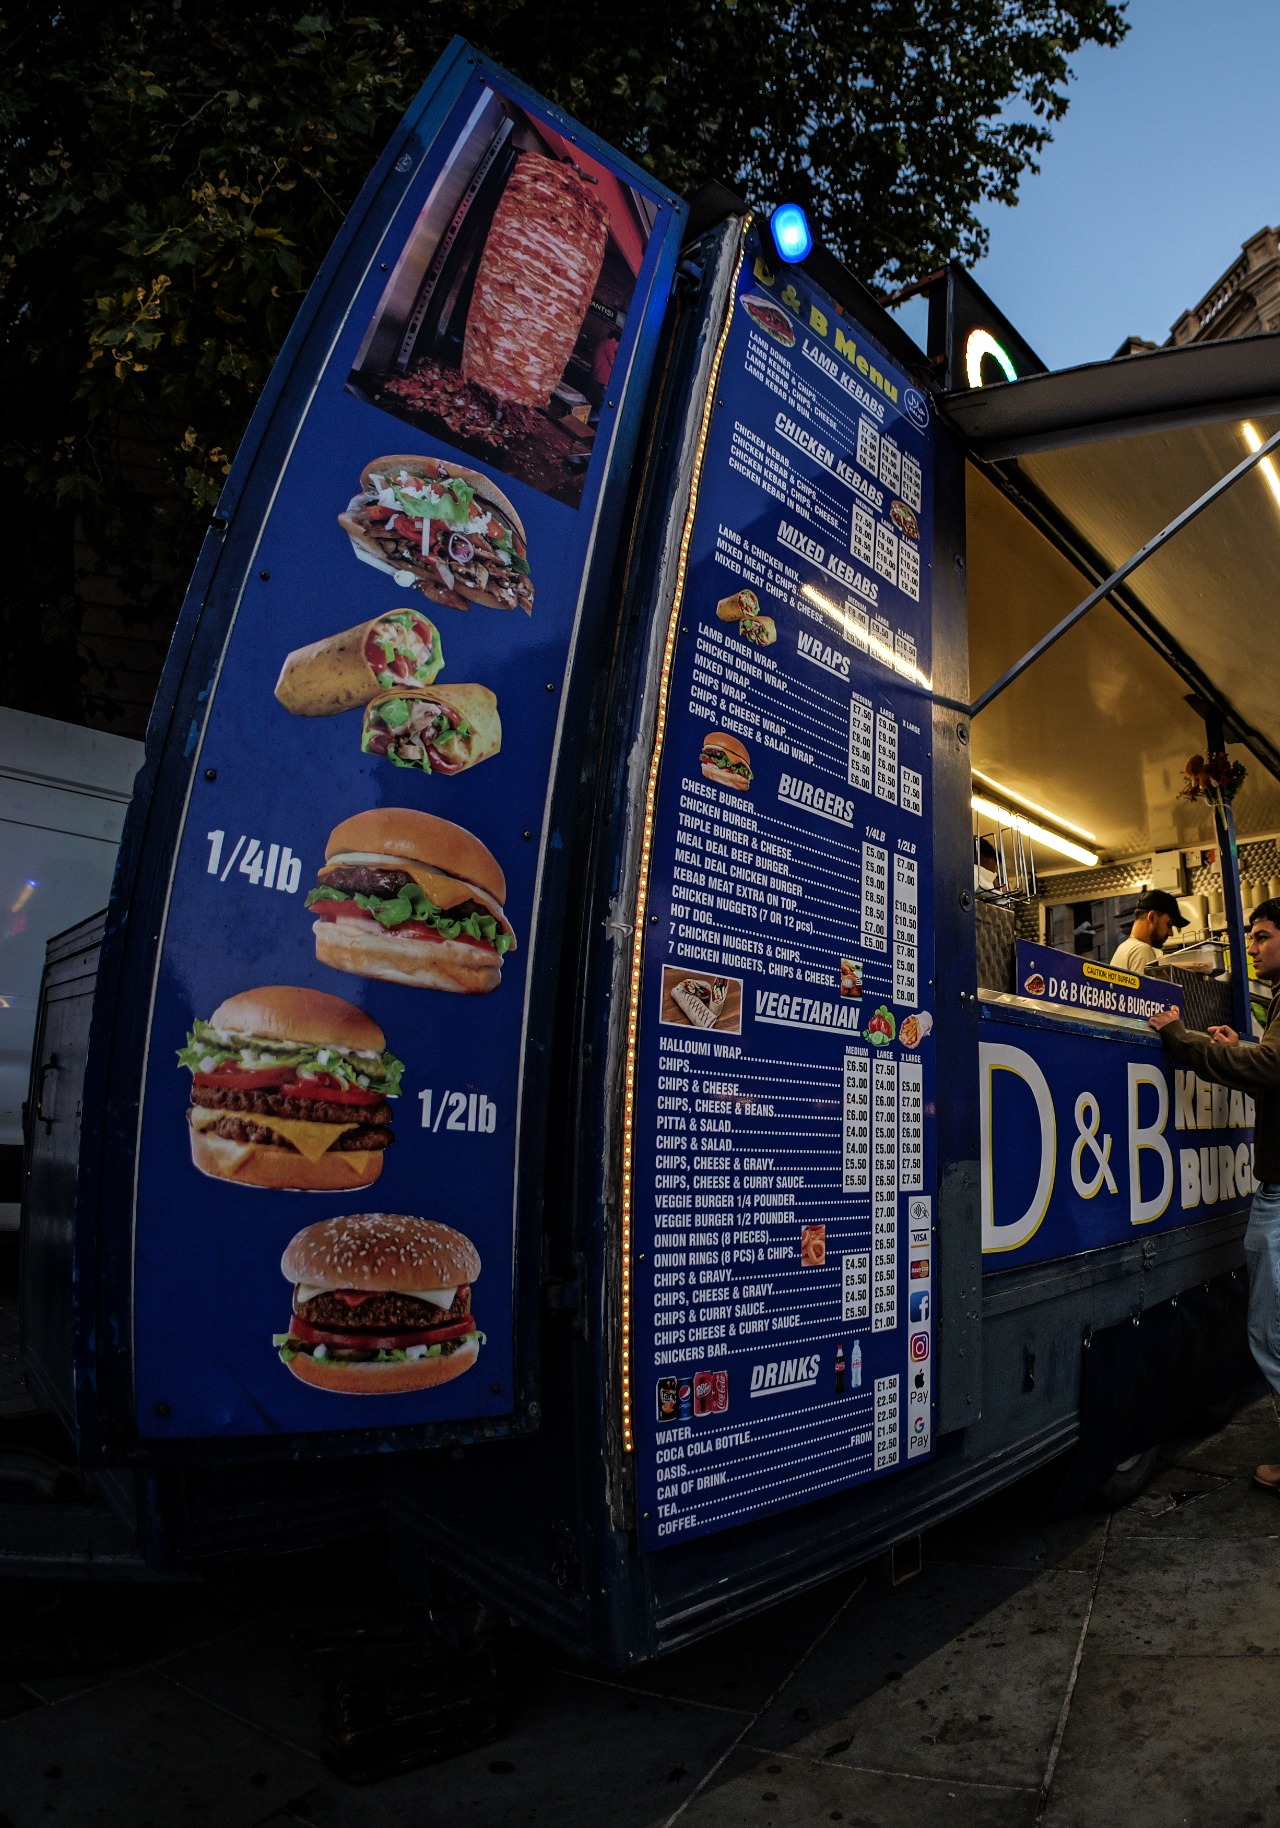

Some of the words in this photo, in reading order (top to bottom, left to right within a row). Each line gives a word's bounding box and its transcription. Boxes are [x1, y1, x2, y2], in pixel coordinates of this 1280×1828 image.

[750, 330, 768, 352] LAMB
[770, 346, 791, 369] DONER
[782, 284, 800, 315] &
[810, 305, 828, 336] B
[835, 328, 898, 403] Menu
[748, 340, 766, 362] LAMB
[769, 356, 790, 381] KEBAB
[791, 375, 796, 386] &
[798, 380, 816, 402] CHIPS
[802, 338, 839, 380] LAMB
[840, 369, 885, 418] KEBABS
[735, 421, 765, 450] CHICKEN
[768, 444, 790, 468] KEBAB
[775, 412, 834, 471] CHICKEN
[836, 458, 884, 508] KEBABS
[729, 457, 760, 486] CHICKEN
[762, 480, 785, 503] KEBAB
[787, 497, 794, 509] IN
[796, 503, 810, 520] BUN
[719, 524, 741, 548] LAMB
[743, 538, 749, 552] &
[751, 544, 782, 572] CHICKEN
[785, 564, 799, 582] MIX
[778, 520, 823, 566] MIXED
[828, 552, 878, 601] KEBABS
[717, 538, 741, 562] MIXED
[744, 553, 766, 576] MEAT
[768, 566, 773, 580] &
[775, 570, 797, 593] CHIPS
[698, 623, 721, 644] LAMB
[725, 636, 751, 659] DONER
[754, 650, 777, 671] WRAP
[798, 631, 850, 674] WRAPS
[695, 654, 721, 676] MIXED
[725, 666, 750, 688] WRAP
[853, 704, 871, 720] £7.50
[689, 701, 718, 726] CHIPS,
[721, 715, 753, 739] CHEESE
[756, 729, 762, 743] &
[764, 733, 789, 754] SALAD
[792, 744, 814, 764] WRAP
[878, 718, 896, 734] £9.00
[682, 778, 716, 801] CHEESE
[719, 791, 754, 813] BURGER
[778, 773, 854, 820] BURGERS
[679, 813, 710, 834] TRIPLE
[714, 824, 748, 846] BURGER
[751, 836, 758, 849] &
[761, 839, 792, 859] CHEESE
[865, 826, 886, 842] 1/4LB
[677, 830, 702, 850] MEAL
[706, 839, 728, 858] DEAL
[731, 847, 753, 865] BEEF
[756, 855, 789, 876] BURGER
[866, 846, 885, 862] £5.00
[897, 838, 916, 854] 1/2LB
[206, 829, 302, 894] 1/4lb
[674, 866, 705, 888] KEBAB
[709, 876, 733, 895] MEAT
[736, 884, 764, 903] EXTRA
[767, 892, 778, 906] ON
[781, 896, 797, 911] TOP
[866, 875, 884, 890] £9.00
[671, 903, 690, 920] HOT
[693, 909, 713, 925] DOG
[672, 885, 713, 908] CHICKEN
[717, 897, 757, 919] NUGGETS
[760, 908, 768, 922] (7
[771, 911, 781, 925] OR
[784, 914, 793, 928] 12
[796, 917, 813, 933] pcs)
[1087, 966, 1107, 978] CAUTION:
[1108, 971, 1116, 980] HOT
[1118, 974, 1137, 986] SURFACE
[1048, 978, 1058, 998] D
[1060, 980, 1068, 1000] &
[1070, 982, 1078, 1002] B
[1080, 984, 1117, 1010] KEBABS
[1118, 994, 1126, 1012] &
[756, 990, 859, 1029] VEGETARIAN
[660, 1037, 710, 1056] HALLOUMI
[714, 1044, 741, 1059] WRAP
[659, 1056, 690, 1073] CHIPS
[847, 1062, 868, 1073] £6.50
[902, 1082, 920, 1092] £5.00
[418, 1088, 496, 1134] 1/2lb
[658, 1096, 692, 1112] CHIPS,
[695, 1099, 732, 1114] CHEESE
[735, 1102, 742, 1114] &
[744, 1103, 774, 1117] BEANS
[657, 1116, 686, 1130] PITTA
[690, 1118, 697, 1131] &
[700, 1119, 731, 1133] SALAD
[979, 1041, 1057, 1254] D
[1070, 1092, 1118, 1199] &
[1128, 1062, 1174, 1225] B
[656, 1156, 690, 1170] CHIPS,
[694, 1157, 730, 1170] CHEESE
[734, 1158, 740, 1170] &
[744, 1158, 774, 1170] GRAVY
[655, 1195, 692, 1208] VEGGIE
[695, 1195, 734, 1207] BURGER
[737, 1195, 751, 1206] 1/4
[754, 1194, 795, 1206] POUNDER
[876, 1191, 894, 1202] £5.00
[654, 1233, 686, 1248] ONION
[689, 1232, 718, 1246] RINGS
[721, 1232, 730, 1245] (8
[734, 1230, 770, 1245] PIECES)
[913, 1233, 927, 1242] VISA
[654, 1310, 685, 1326] CHIPS
[688, 1309, 696, 1322] &
[700, 1305, 732, 1321] CURRY
[735, 1302, 764, 1317] SAUCE
[654, 1346, 704, 1365] SNICKERS
[708, 1343, 727, 1357] BAR
[751, 1354, 820, 1390] DRINKS
[877, 1378, 897, 1391] £1.50
[910, 1391, 928, 1404] Pay
[656, 1426, 691, 1445] WATER
[851, 1431, 872, 1448] FROM
[877, 1423, 897, 1437] £1.50
[656, 1446, 684, 1464] COCA
[687, 1440, 713, 1457] COLA
[715, 1432, 750, 1451] BOTTLE
[910, 1435, 928, 1450] Pay
[877, 1453, 897, 1467] £2.50
[657, 1463, 687, 1482] OASIS
[657, 1483, 678, 1500] CAN
[681, 1480, 694, 1494] OF
[697, 1472, 727, 1491] DRINK
[658, 1503, 678, 1518] TEA
[658, 1515, 697, 1536] COFFEE
